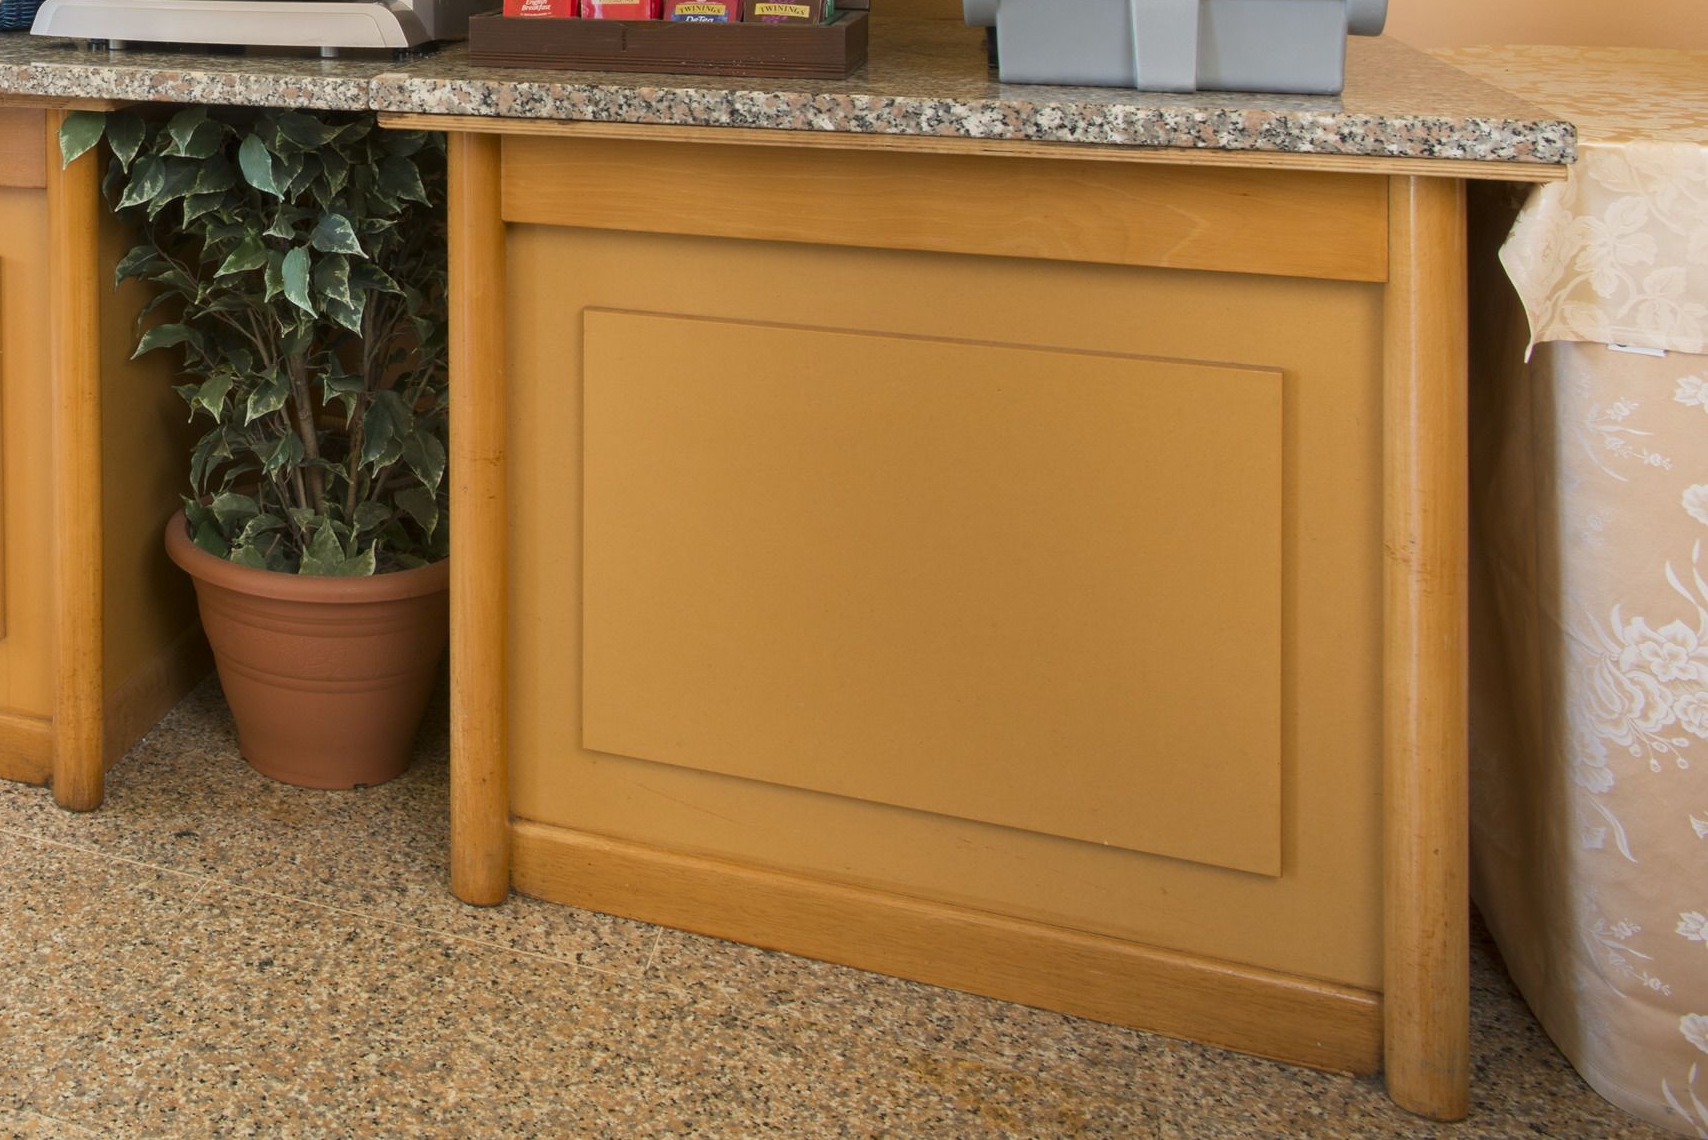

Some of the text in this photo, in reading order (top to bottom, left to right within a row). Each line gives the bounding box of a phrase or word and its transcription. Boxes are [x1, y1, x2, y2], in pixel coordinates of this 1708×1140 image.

[521, 4, 551, 12] Breakfast
[680, 5, 722, 14] TWININGS
[760, 5, 806, 16] TWININGS
